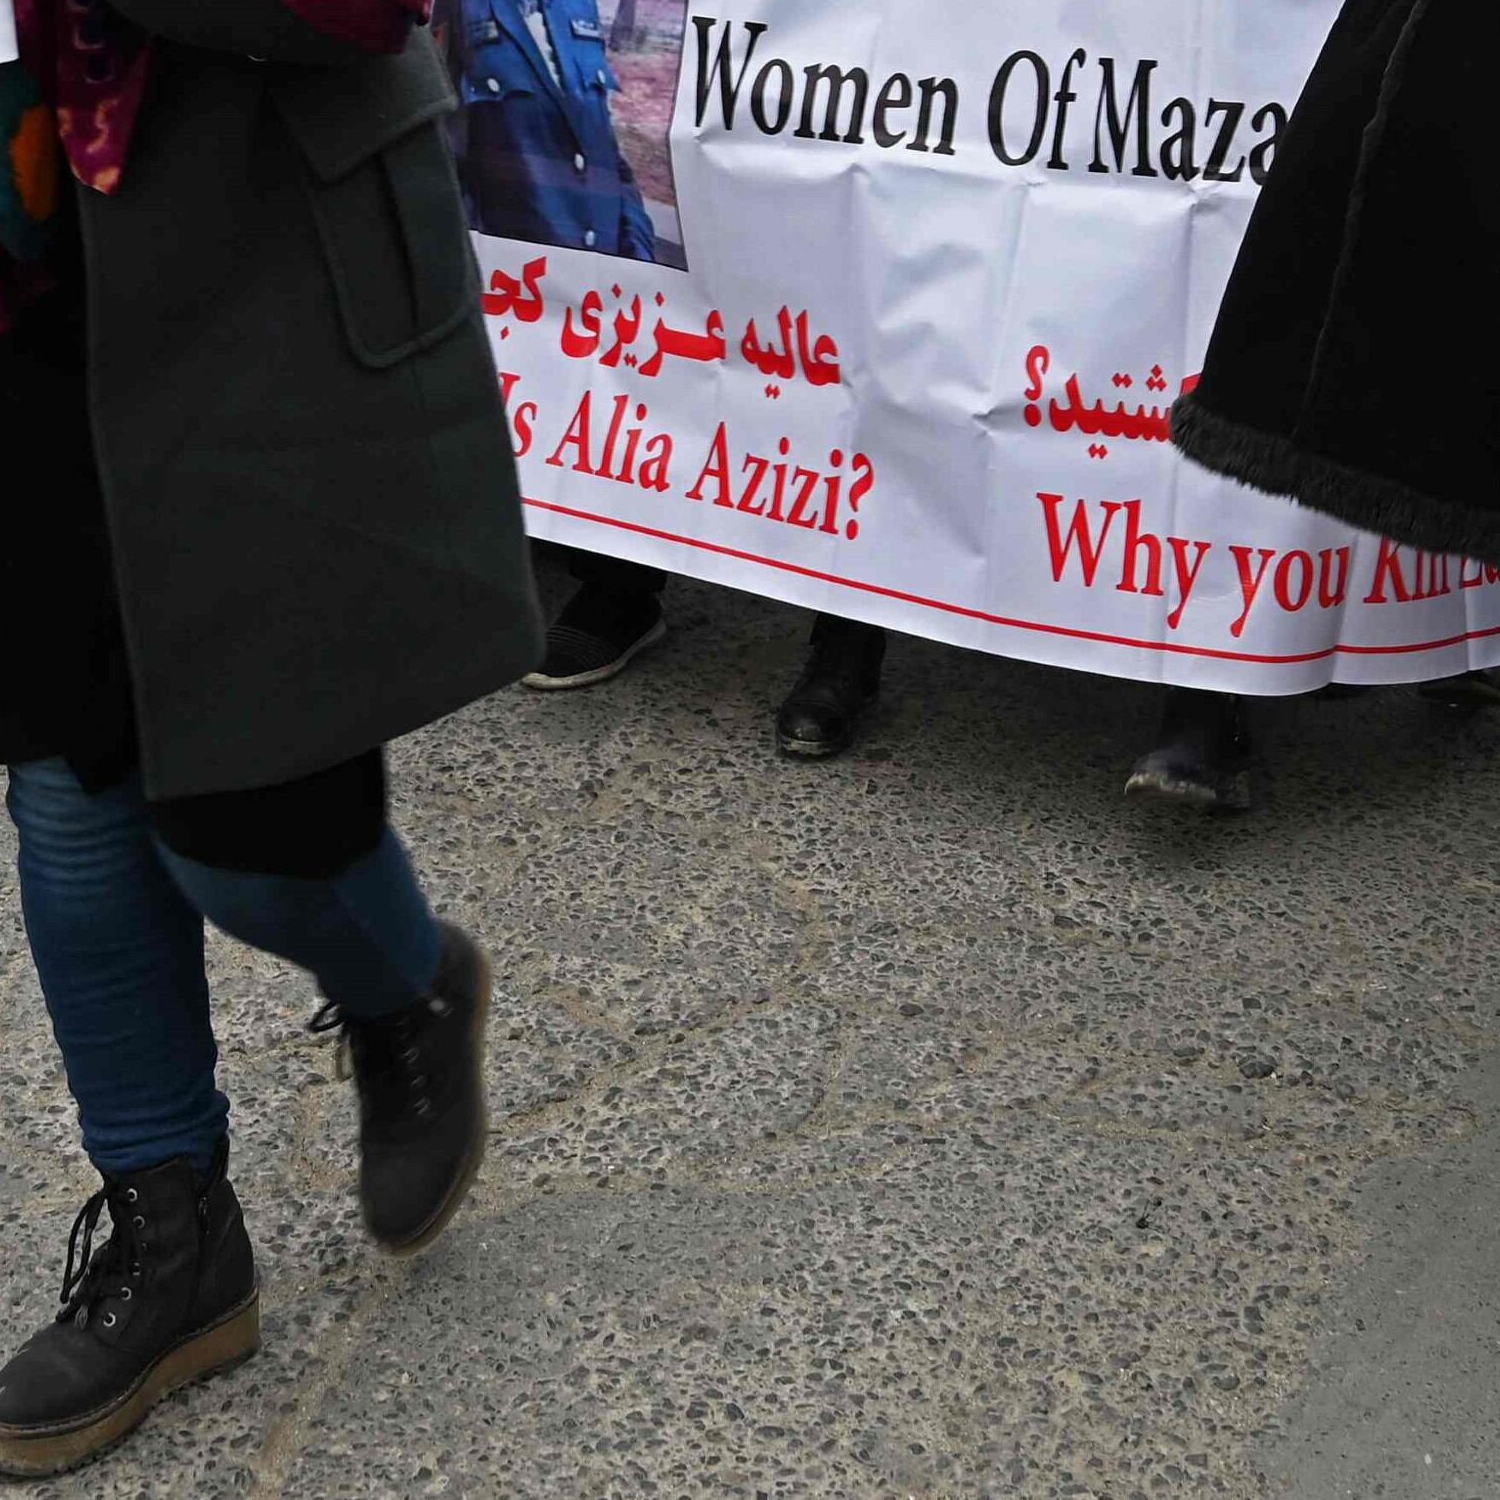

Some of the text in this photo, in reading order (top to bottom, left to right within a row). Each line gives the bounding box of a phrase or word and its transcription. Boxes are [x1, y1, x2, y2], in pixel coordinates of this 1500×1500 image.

[691, 15, 1298, 186] Women Of Maza
[545, 390, 672, 492] Alia
[684, 421, 875, 540] Azizi?
[1036, 492, 1212, 630] Why
[1229, 526, 1350, 637] you
